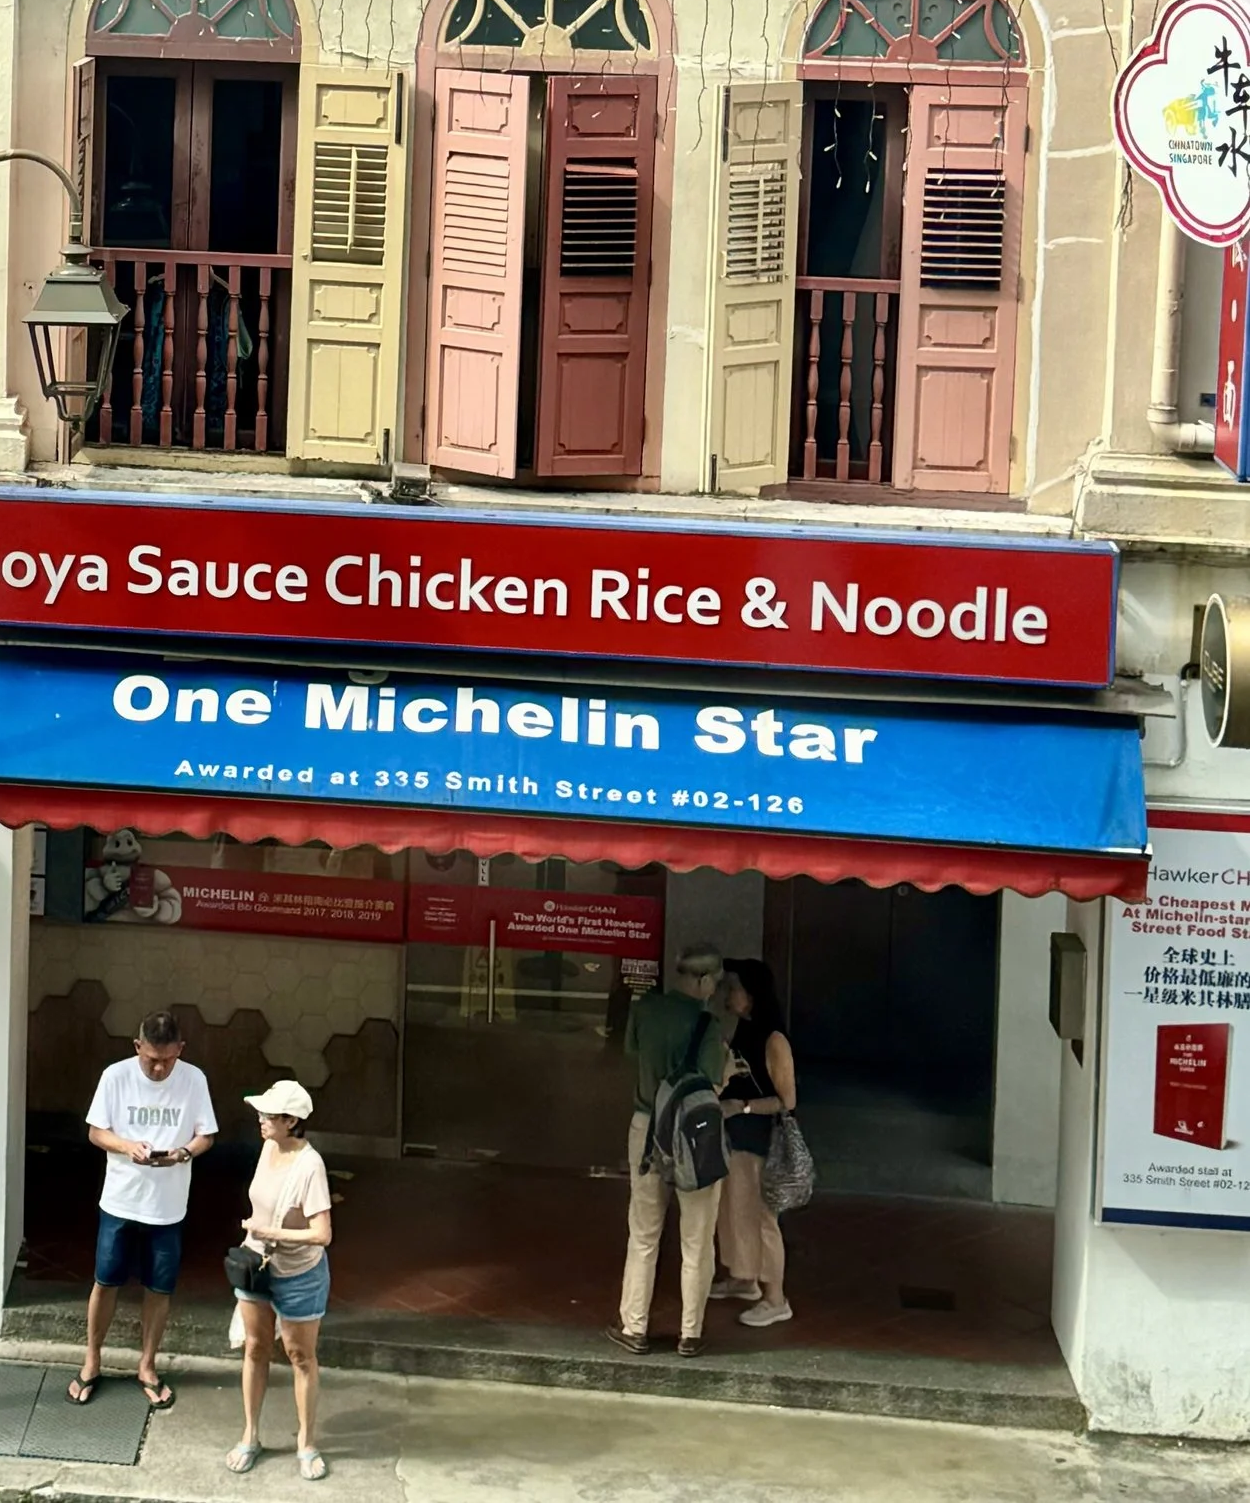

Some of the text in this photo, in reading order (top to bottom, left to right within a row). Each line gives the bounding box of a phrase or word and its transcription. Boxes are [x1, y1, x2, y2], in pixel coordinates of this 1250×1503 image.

[1168, 139, 1213, 152] CHINATOWN
[1169, 153, 1212, 166] SINGAPORE
[127, 544, 309, 602] Sauce
[325, 553, 568, 616] Chicken
[591, 567, 721, 625] Rice
[741, 576, 789, 630] &
[811, 581, 1049, 645] Noodle
[112, 675, 878, 764] One Michelin Star
[174, 760, 804, 815] Awarded at 335 Smith Street #02-126
[182, 886, 254, 902] MICHELIN
[1122, 907, 1141, 918] At
[1158, 895, 1236, 914] Cheapest
[513, 912, 535, 922] The
[536, 914, 575, 925] World's
[578, 916, 602, 926] First
[508, 922, 555, 933] Awarded
[557, 925, 579, 935] One
[628, 930, 651, 940] Star
[1132, 921, 1182, 936] Street
[1187, 925, 1226, 938] Food
[1162, 946, 1236, 967] 全球史上
[127, 1104, 182, 1127] TODAY
[1148, 1162, 1195, 1176] Awarded
[1222, 1168, 1232, 1178] at
[1123, 1173, 1142, 1184] 335
[1146, 1175, 1176, 1187] Smith
[1179, 1177, 1211, 1189] Street
